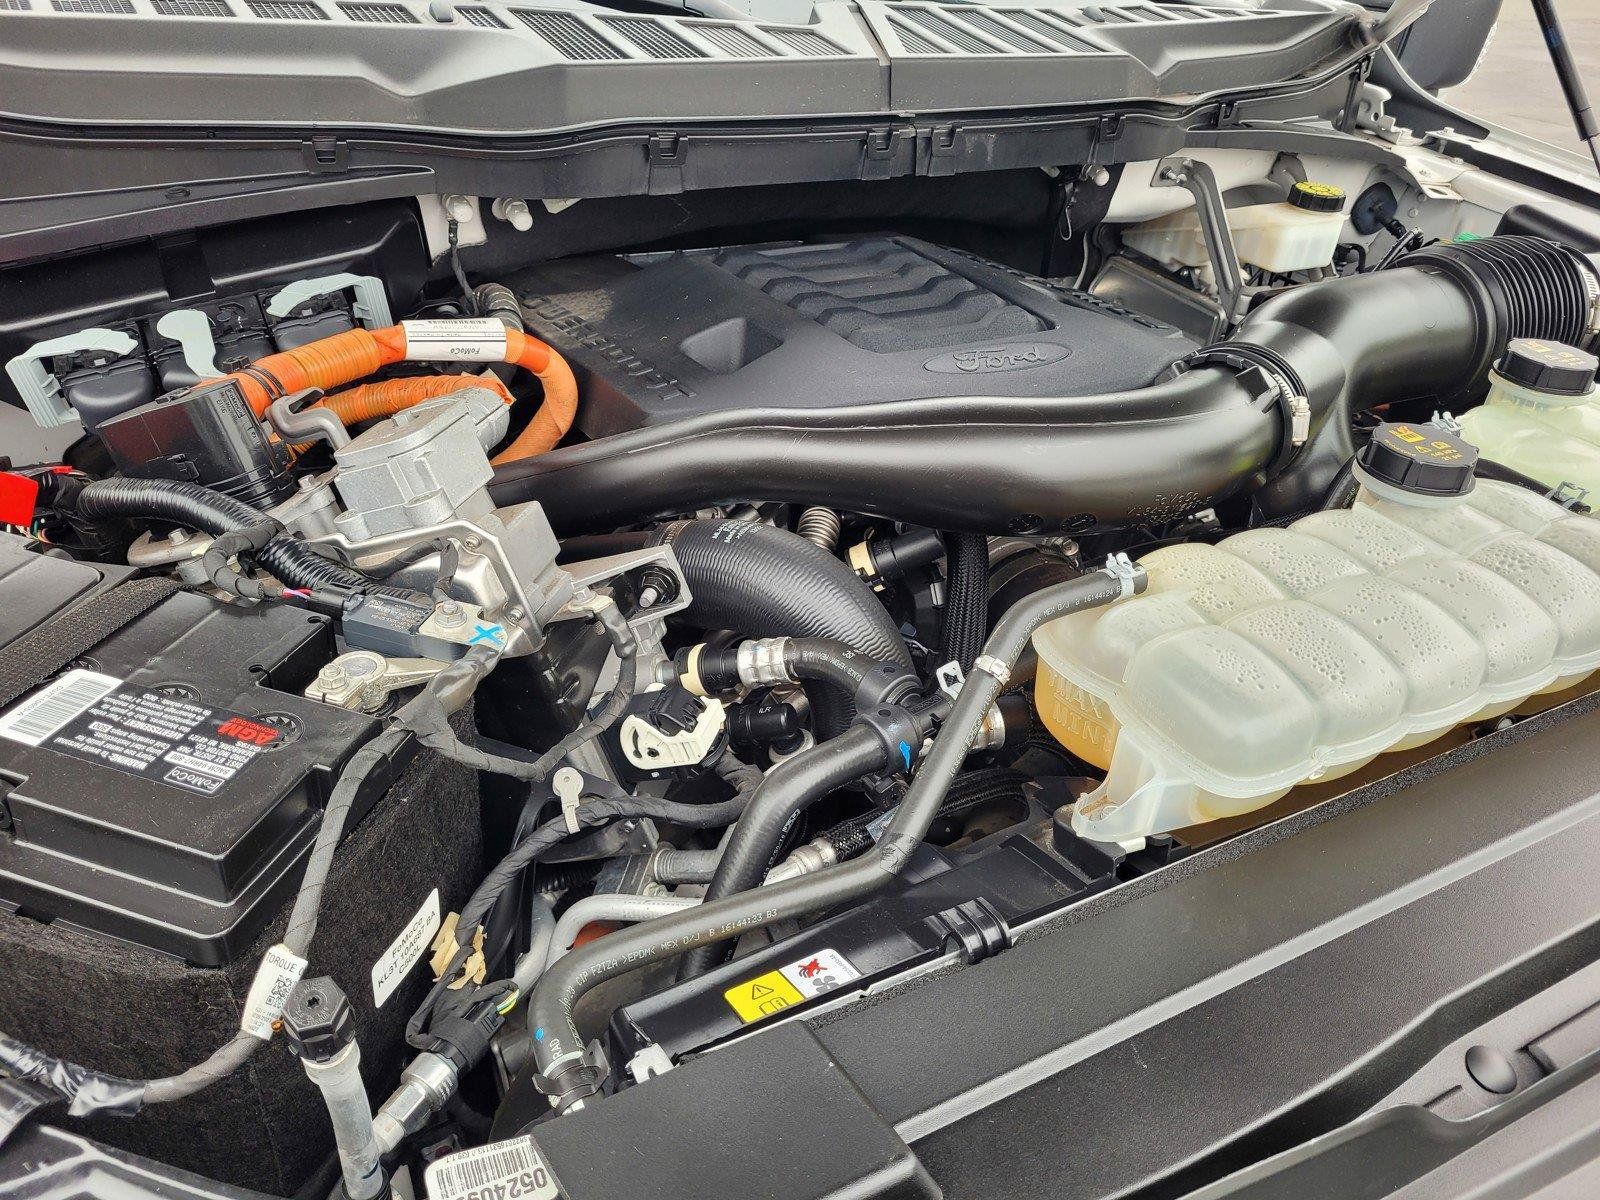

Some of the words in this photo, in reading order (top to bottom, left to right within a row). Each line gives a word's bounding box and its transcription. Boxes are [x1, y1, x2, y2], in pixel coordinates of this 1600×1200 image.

[450, 347, 481, 355] FoMoCo
[952, 346, 1047, 372] Ford
[122, 718, 184, 739] AVERTISSEMENT
[215, 721, 275, 746] AGM
[1053, 703, 1098, 744] MIN
[105, 753, 149, 769] WARNING:
[167, 769, 220, 789] FoMoCo
[391, 917, 423, 958] FoMoCo
[660, 939, 680, 951] MEX
[266, 952, 298, 973] TORQUE
[550, 1037, 564, 1061] RAD
